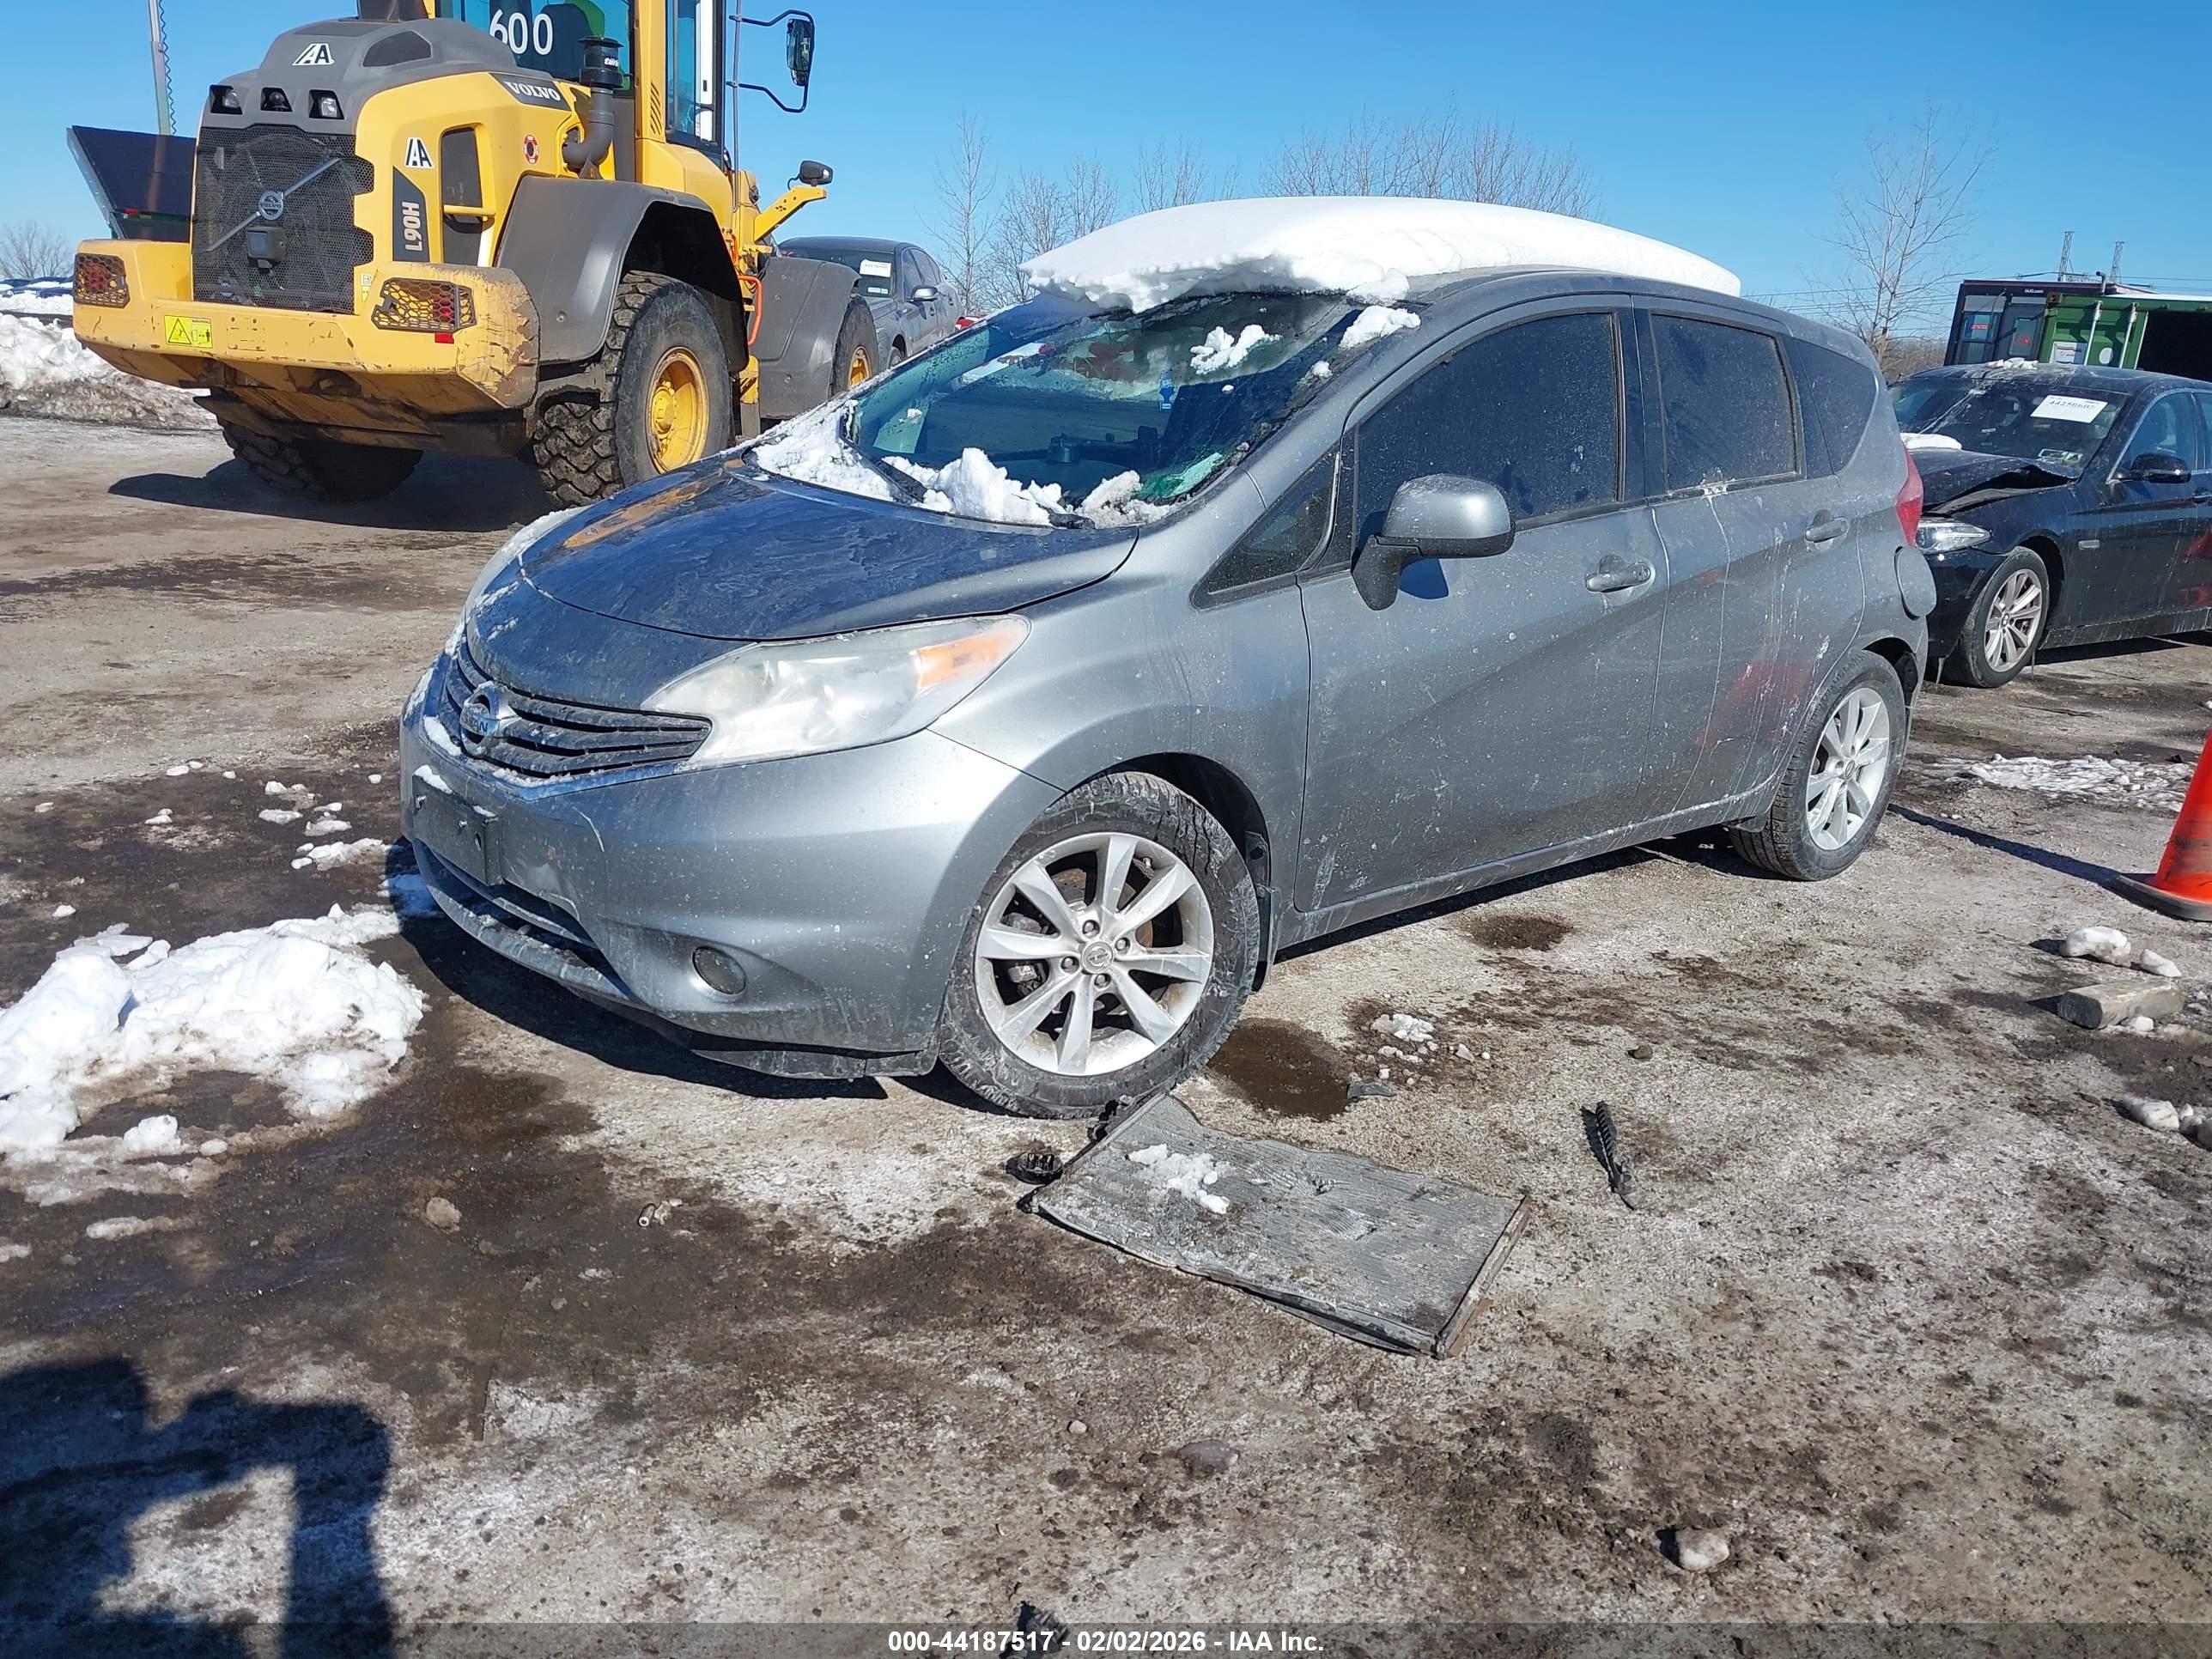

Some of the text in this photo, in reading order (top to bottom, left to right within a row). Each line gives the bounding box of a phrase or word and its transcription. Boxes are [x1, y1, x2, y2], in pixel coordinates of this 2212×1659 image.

[489, 9, 553, 55] 600
[503, 82, 561, 100] VOLVO
[402, 201, 422, 252] L90H
